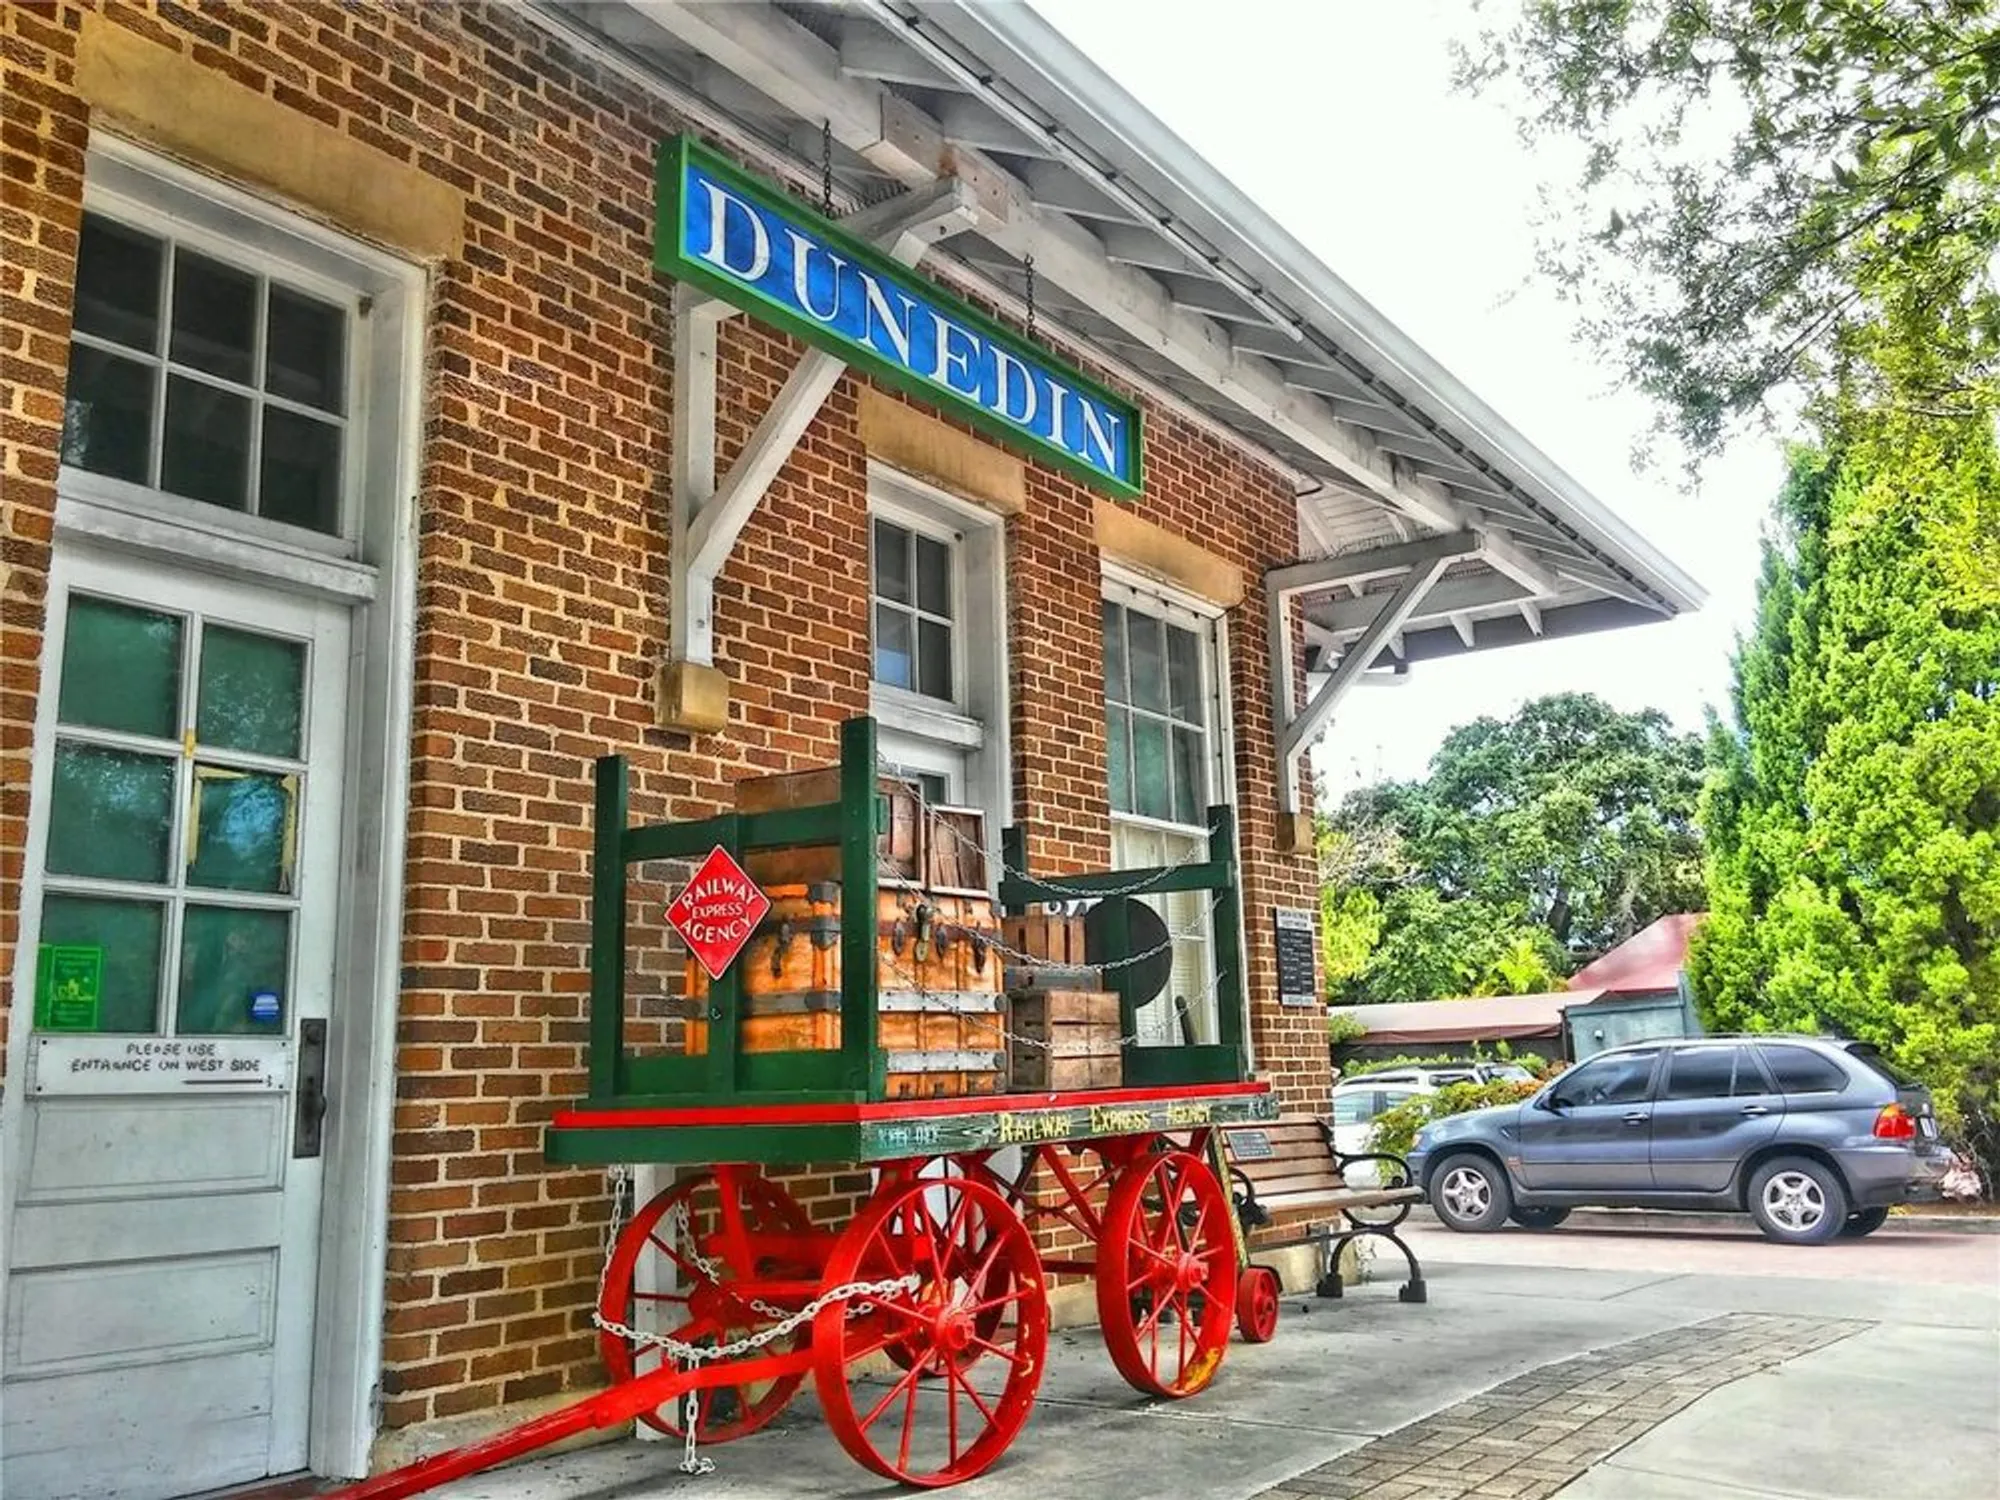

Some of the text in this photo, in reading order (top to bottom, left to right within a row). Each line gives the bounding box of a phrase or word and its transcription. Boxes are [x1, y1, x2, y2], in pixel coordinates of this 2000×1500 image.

[698, 177, 1122, 475] DUNEDIN
[680, 877, 758, 910] RAILWAY
[691, 902, 743, 919] EXPRESS
[680, 911, 751, 943] AGENCY
[126, 1042, 215, 1056] PLEASE USE
[186, 1059, 223, 1072] WEST
[230, 1058, 260, 1072] SIDE
[999, 1112, 1072, 1143] RAILWAY
[1089, 1105, 1151, 1133] EXPRESS
[1166, 1101, 1212, 1126] AGENCY
